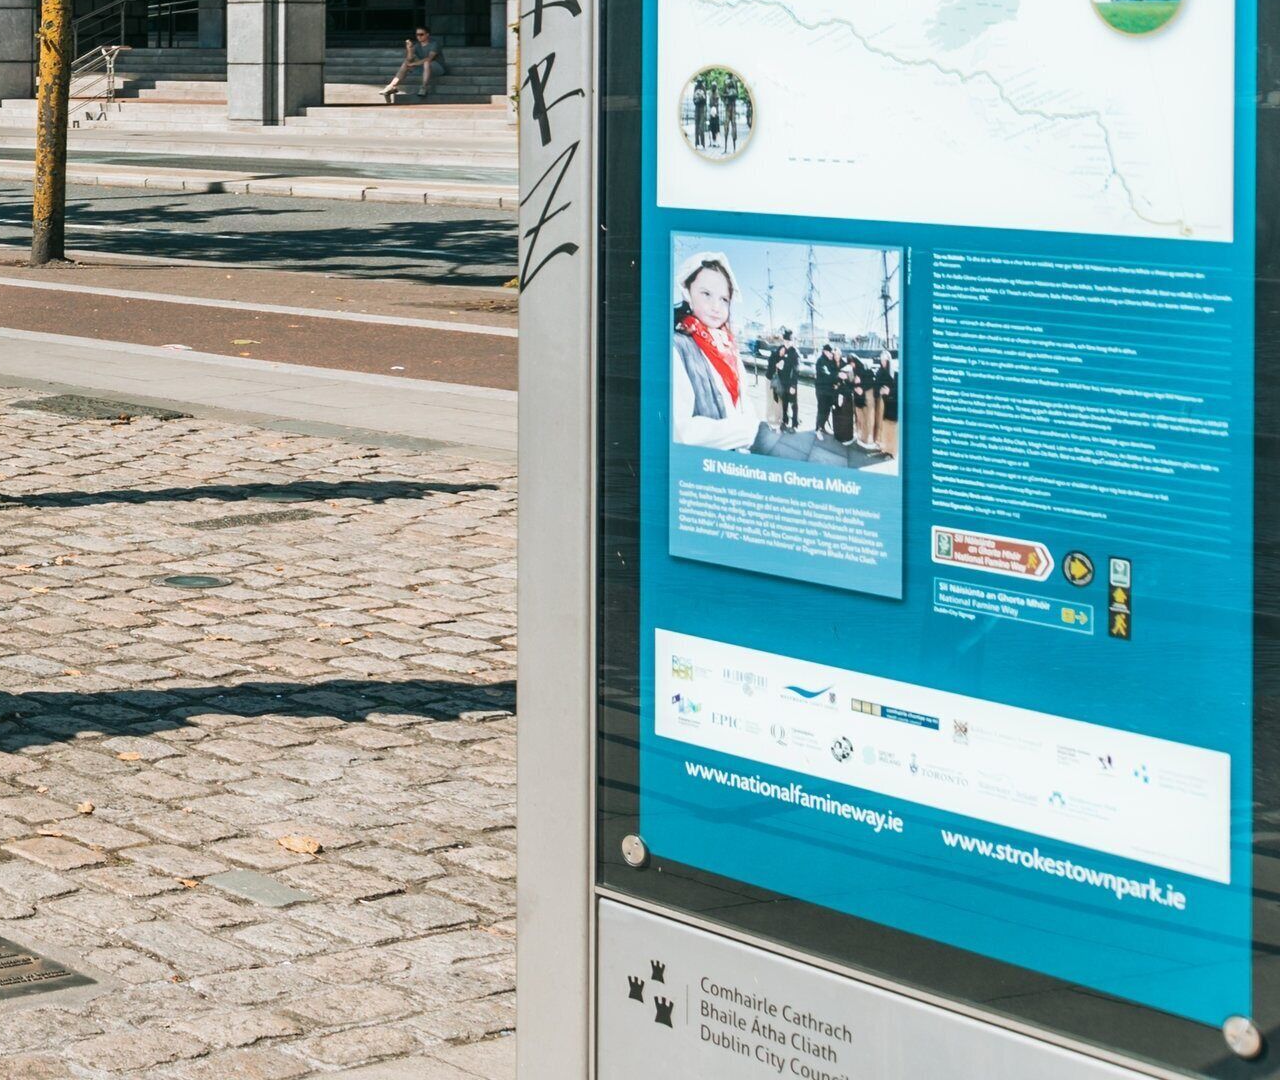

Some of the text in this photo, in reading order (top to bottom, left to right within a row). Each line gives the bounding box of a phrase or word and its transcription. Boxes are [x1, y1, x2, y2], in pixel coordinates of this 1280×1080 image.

[703, 458, 861, 496] Slí Náisiúnta an Ghorta Mhóir
[685, 760, 904, 833] www.nationalfamineway.ie
[941, 829, 1186, 910] www.strokestownpark.ie
[700, 976, 852, 1044] Comhairle Cathrach
[700, 1000, 837, 1064] Bhaile Átha Cliath
[700, 1024, 849, 1080] Dublin City Coun
